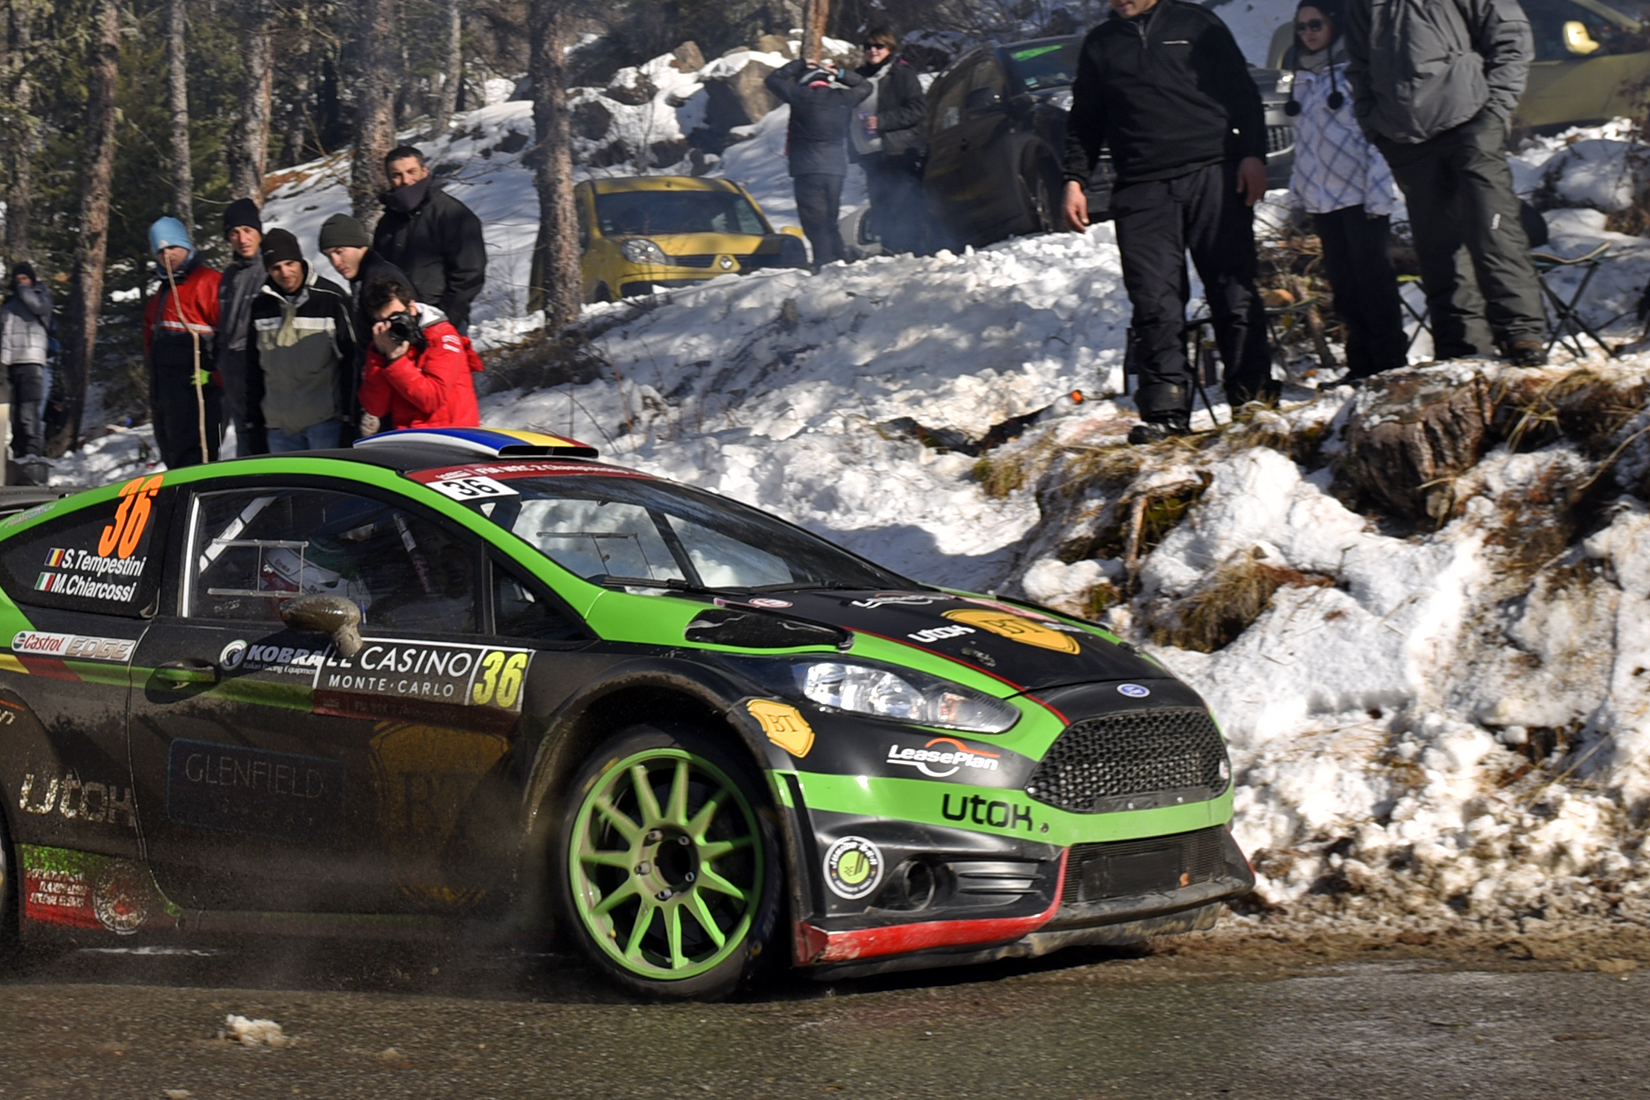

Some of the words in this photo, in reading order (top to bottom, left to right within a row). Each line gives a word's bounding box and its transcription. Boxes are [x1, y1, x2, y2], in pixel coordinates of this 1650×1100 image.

[442, 479, 499, 496] 36
[98, 475, 164, 559] 36
[61, 549, 147, 577] S.Tempestini
[51, 575, 136, 602] M.Chiarcossi
[23, 634, 68, 652] Castrol
[65, 637, 134, 660] EDGE
[246, 644, 326, 667] KOBRA
[360, 645, 472, 677] CASINO
[472, 651, 527, 708] 36
[765, 713, 800, 733] BT
[887, 744, 1000, 771] LeasePlan
[185, 753, 326, 800] GLENFIELD
